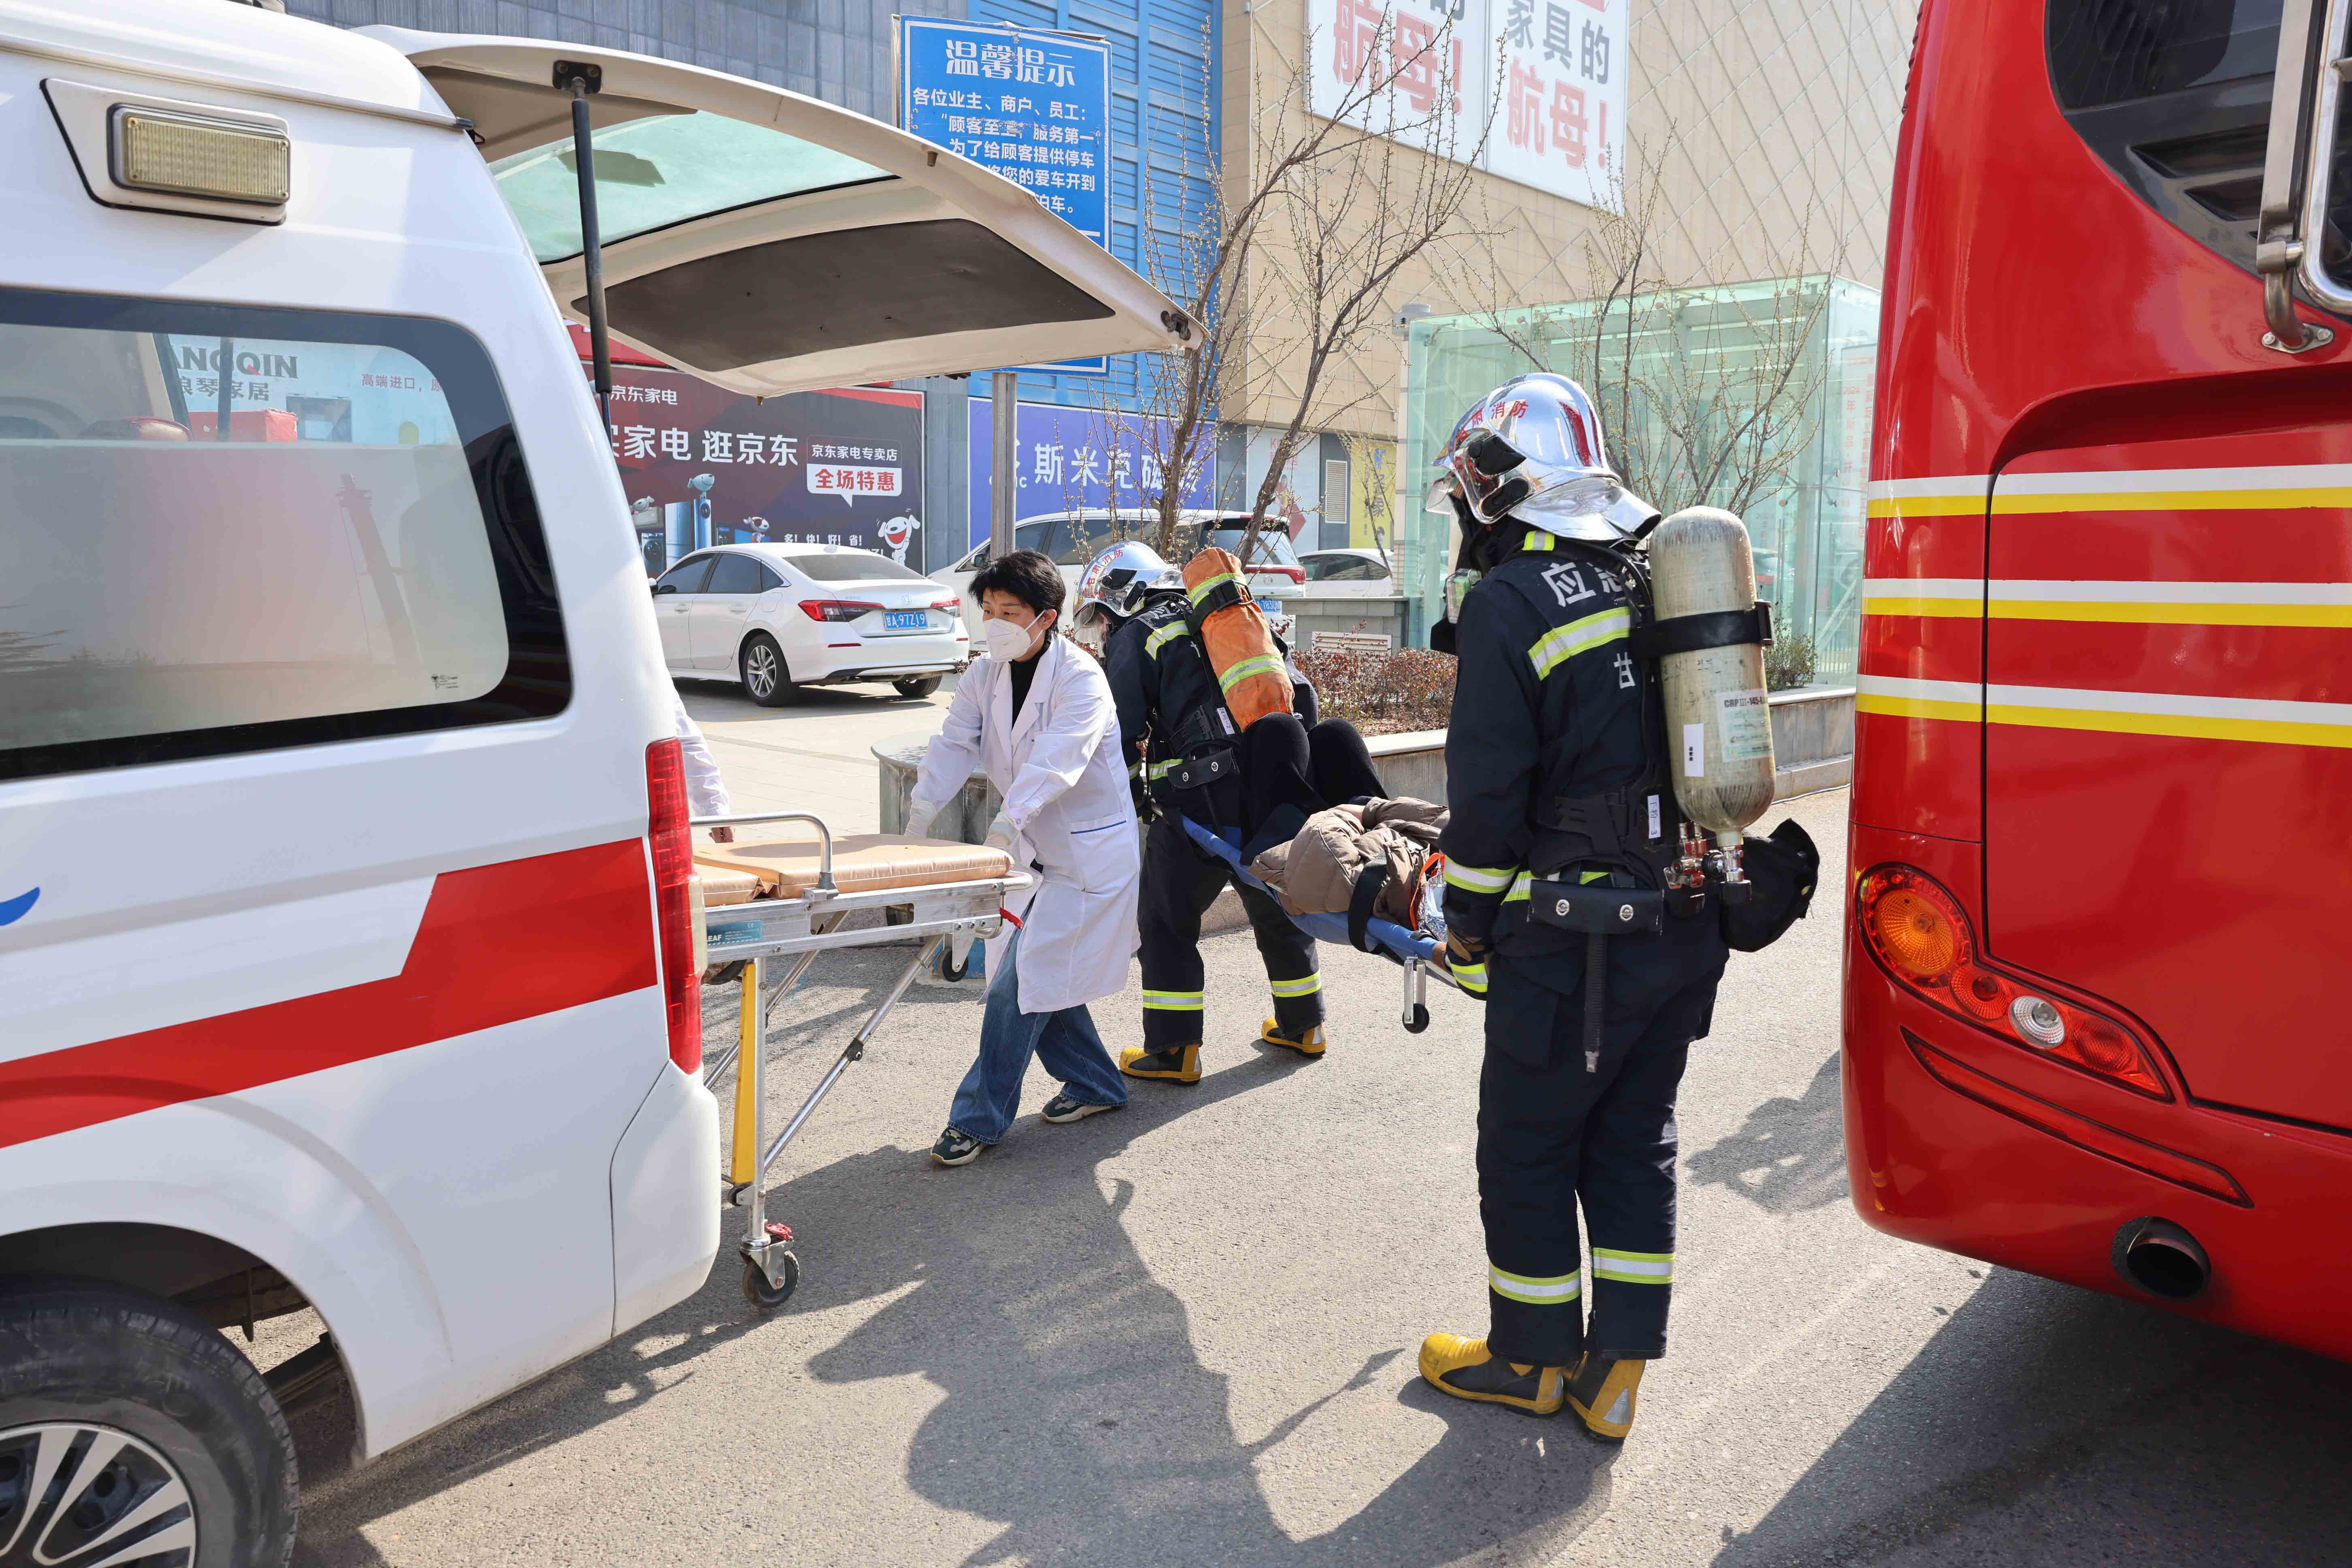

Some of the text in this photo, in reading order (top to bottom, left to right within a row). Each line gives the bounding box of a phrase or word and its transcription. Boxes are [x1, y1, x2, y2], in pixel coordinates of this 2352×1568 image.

[946, 39, 1075, 87] 温馨提示
[949, 138, 1095, 168] 为了给顾客提供停车
[610, 385, 678, 405] 京东家电
[702, 429, 799, 466] 逛京东
[812, 445, 897, 461] 京东家电专卖店
[815, 469, 894, 491] 全场特惠
[1087, 550, 1123, 585] 甘肃消防
